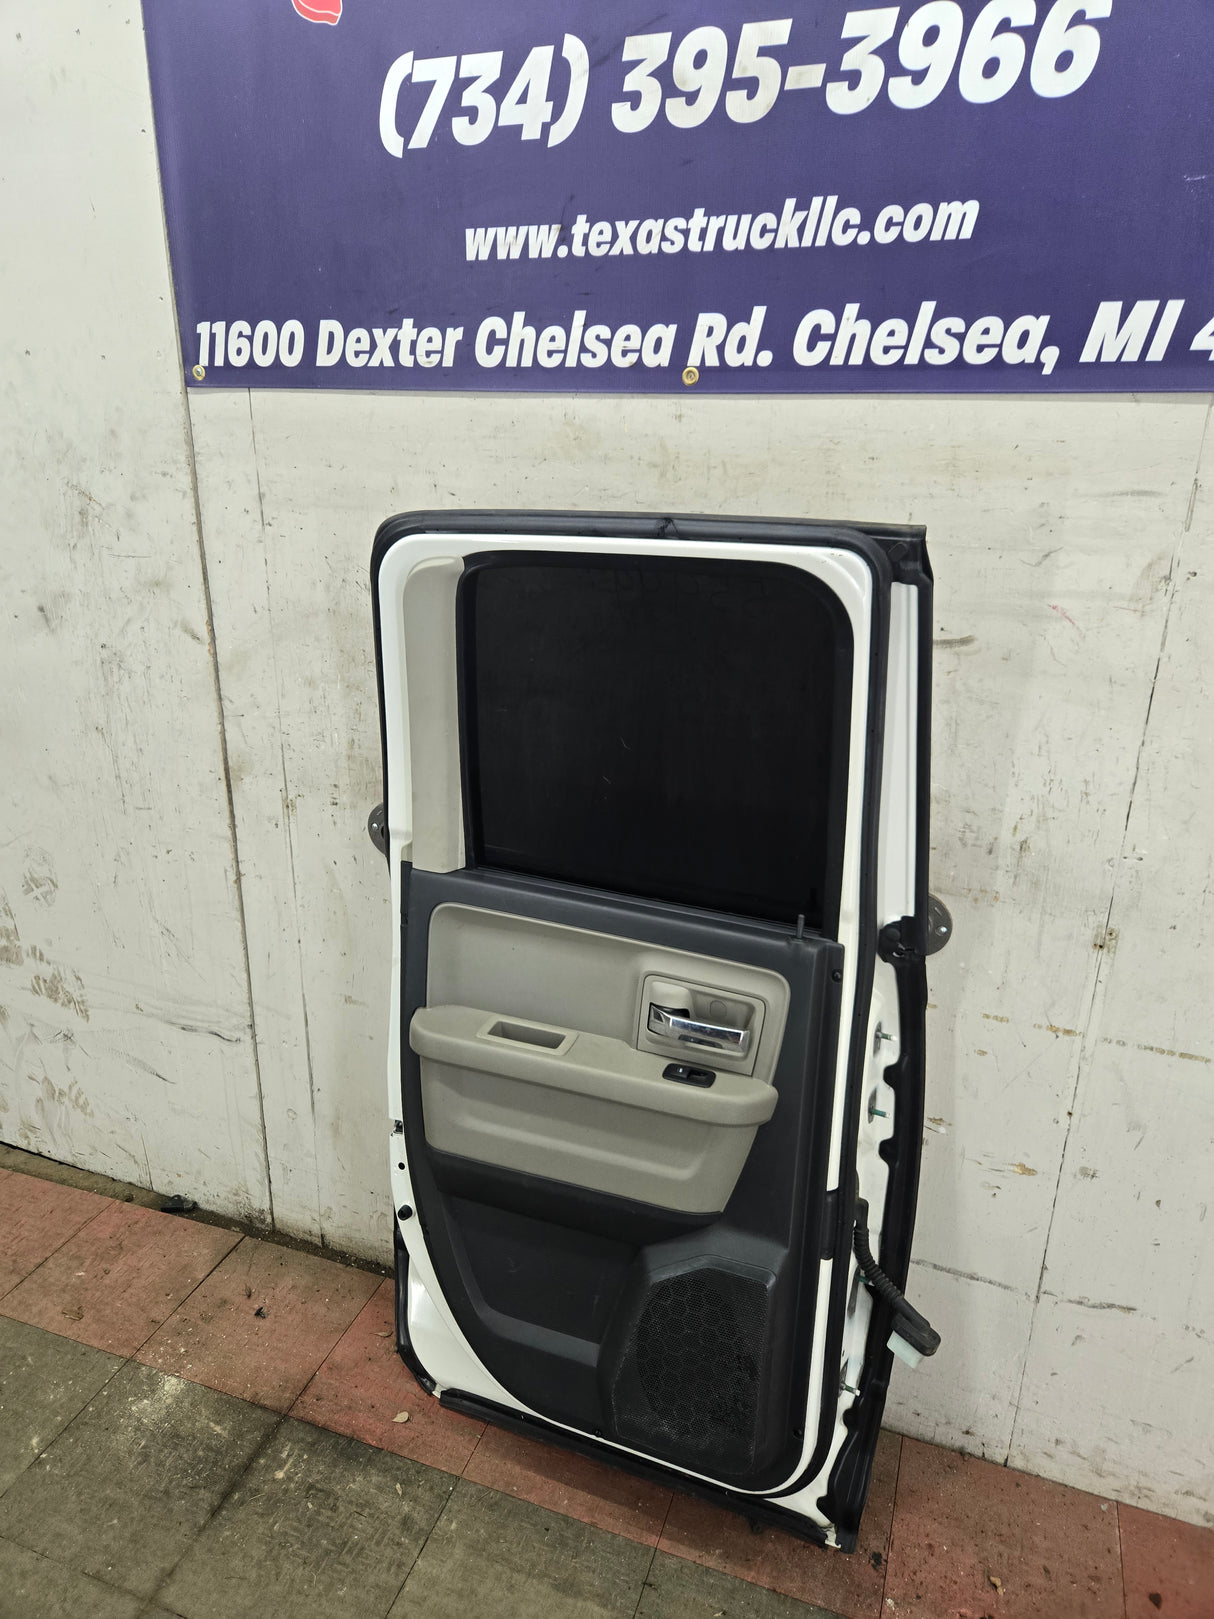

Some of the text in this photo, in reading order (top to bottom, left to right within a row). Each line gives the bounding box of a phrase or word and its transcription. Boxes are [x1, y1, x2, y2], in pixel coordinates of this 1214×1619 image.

[379, 0, 1112, 158] (734) 395-3966
[466, 195, 979, 261] www.texastruckllc.com
[196, 320, 304, 367] 11600
[316, 319, 464, 368] Dexter
[475, 310, 677, 368] Chelsea
[687, 306, 772, 367] Rd.
[793, 301, 1059, 374] Chelsea,
[1079, 300, 1185, 362] MI
